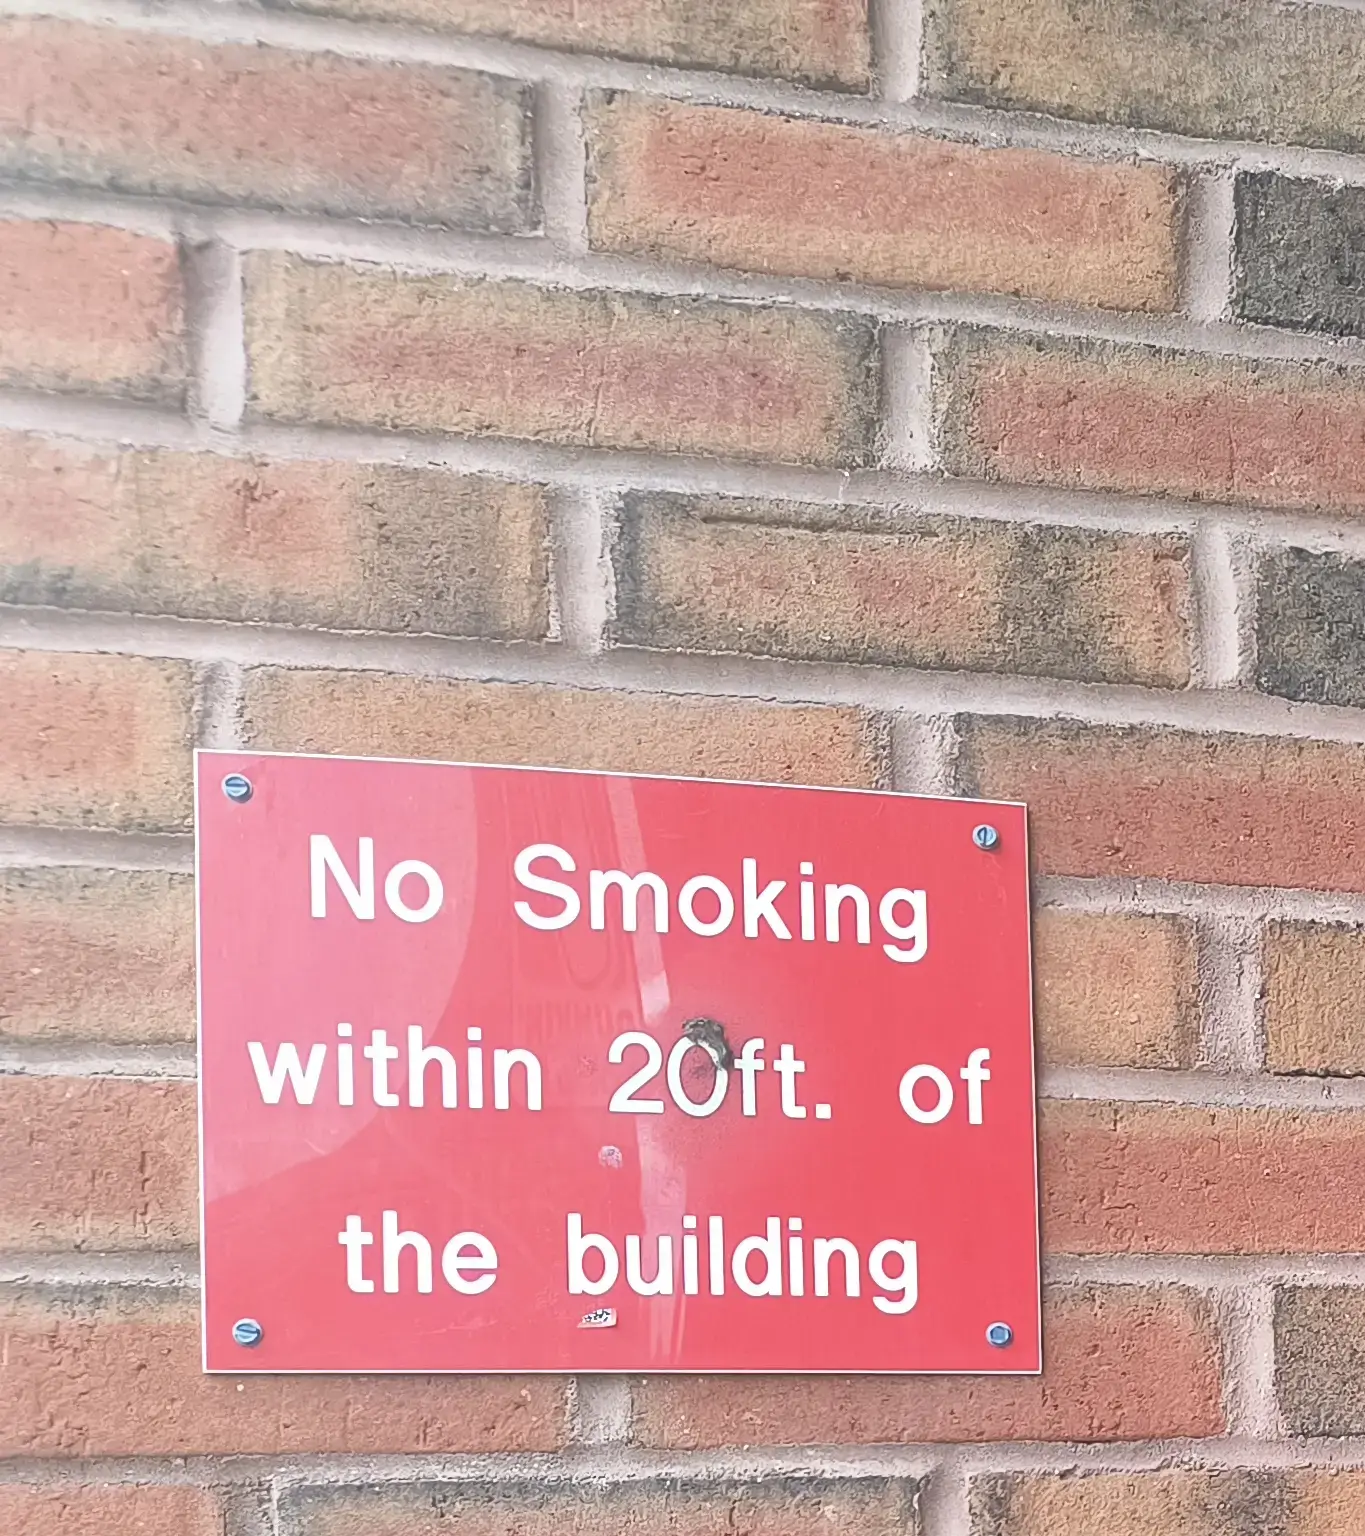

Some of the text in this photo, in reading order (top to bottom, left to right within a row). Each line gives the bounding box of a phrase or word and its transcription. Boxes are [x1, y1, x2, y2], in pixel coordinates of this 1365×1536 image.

[308, 834, 929, 964] No Smoking
[246, 1021, 992, 1126] within 20ft. of
[338, 1210, 920, 1316] the building
